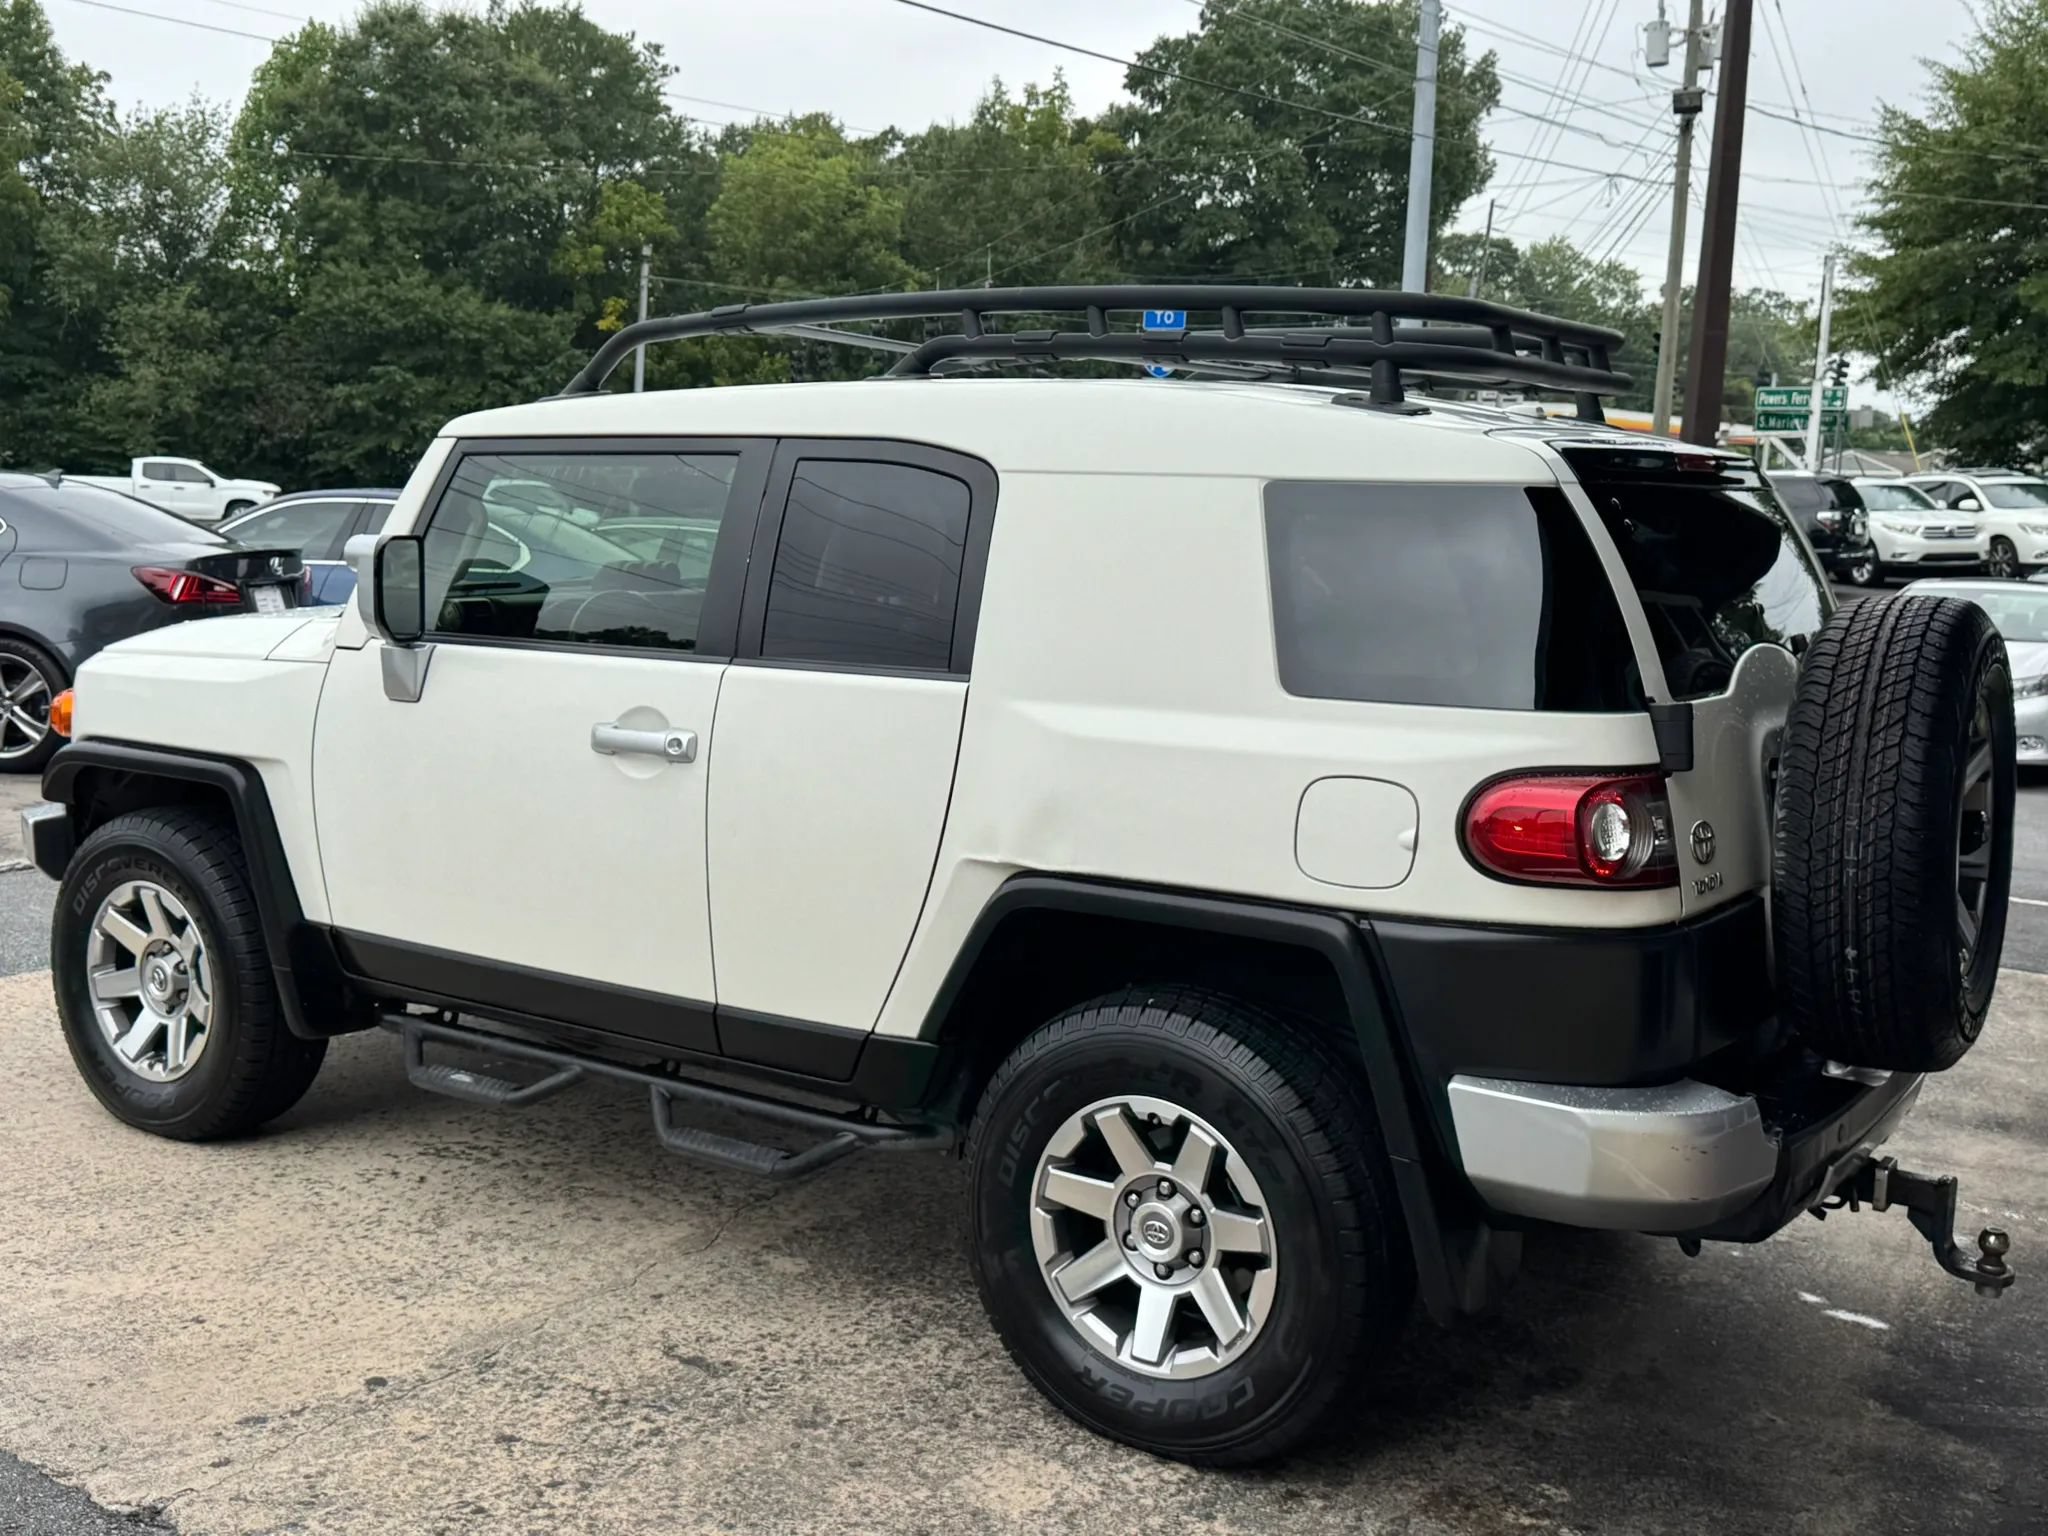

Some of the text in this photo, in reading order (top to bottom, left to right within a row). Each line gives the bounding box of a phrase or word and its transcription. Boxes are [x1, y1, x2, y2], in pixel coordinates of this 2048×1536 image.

[1154, 311, 1175, 324] TO
[1758, 391, 1787, 405] Powers
[1074, 1365, 1255, 1422] COOPER
